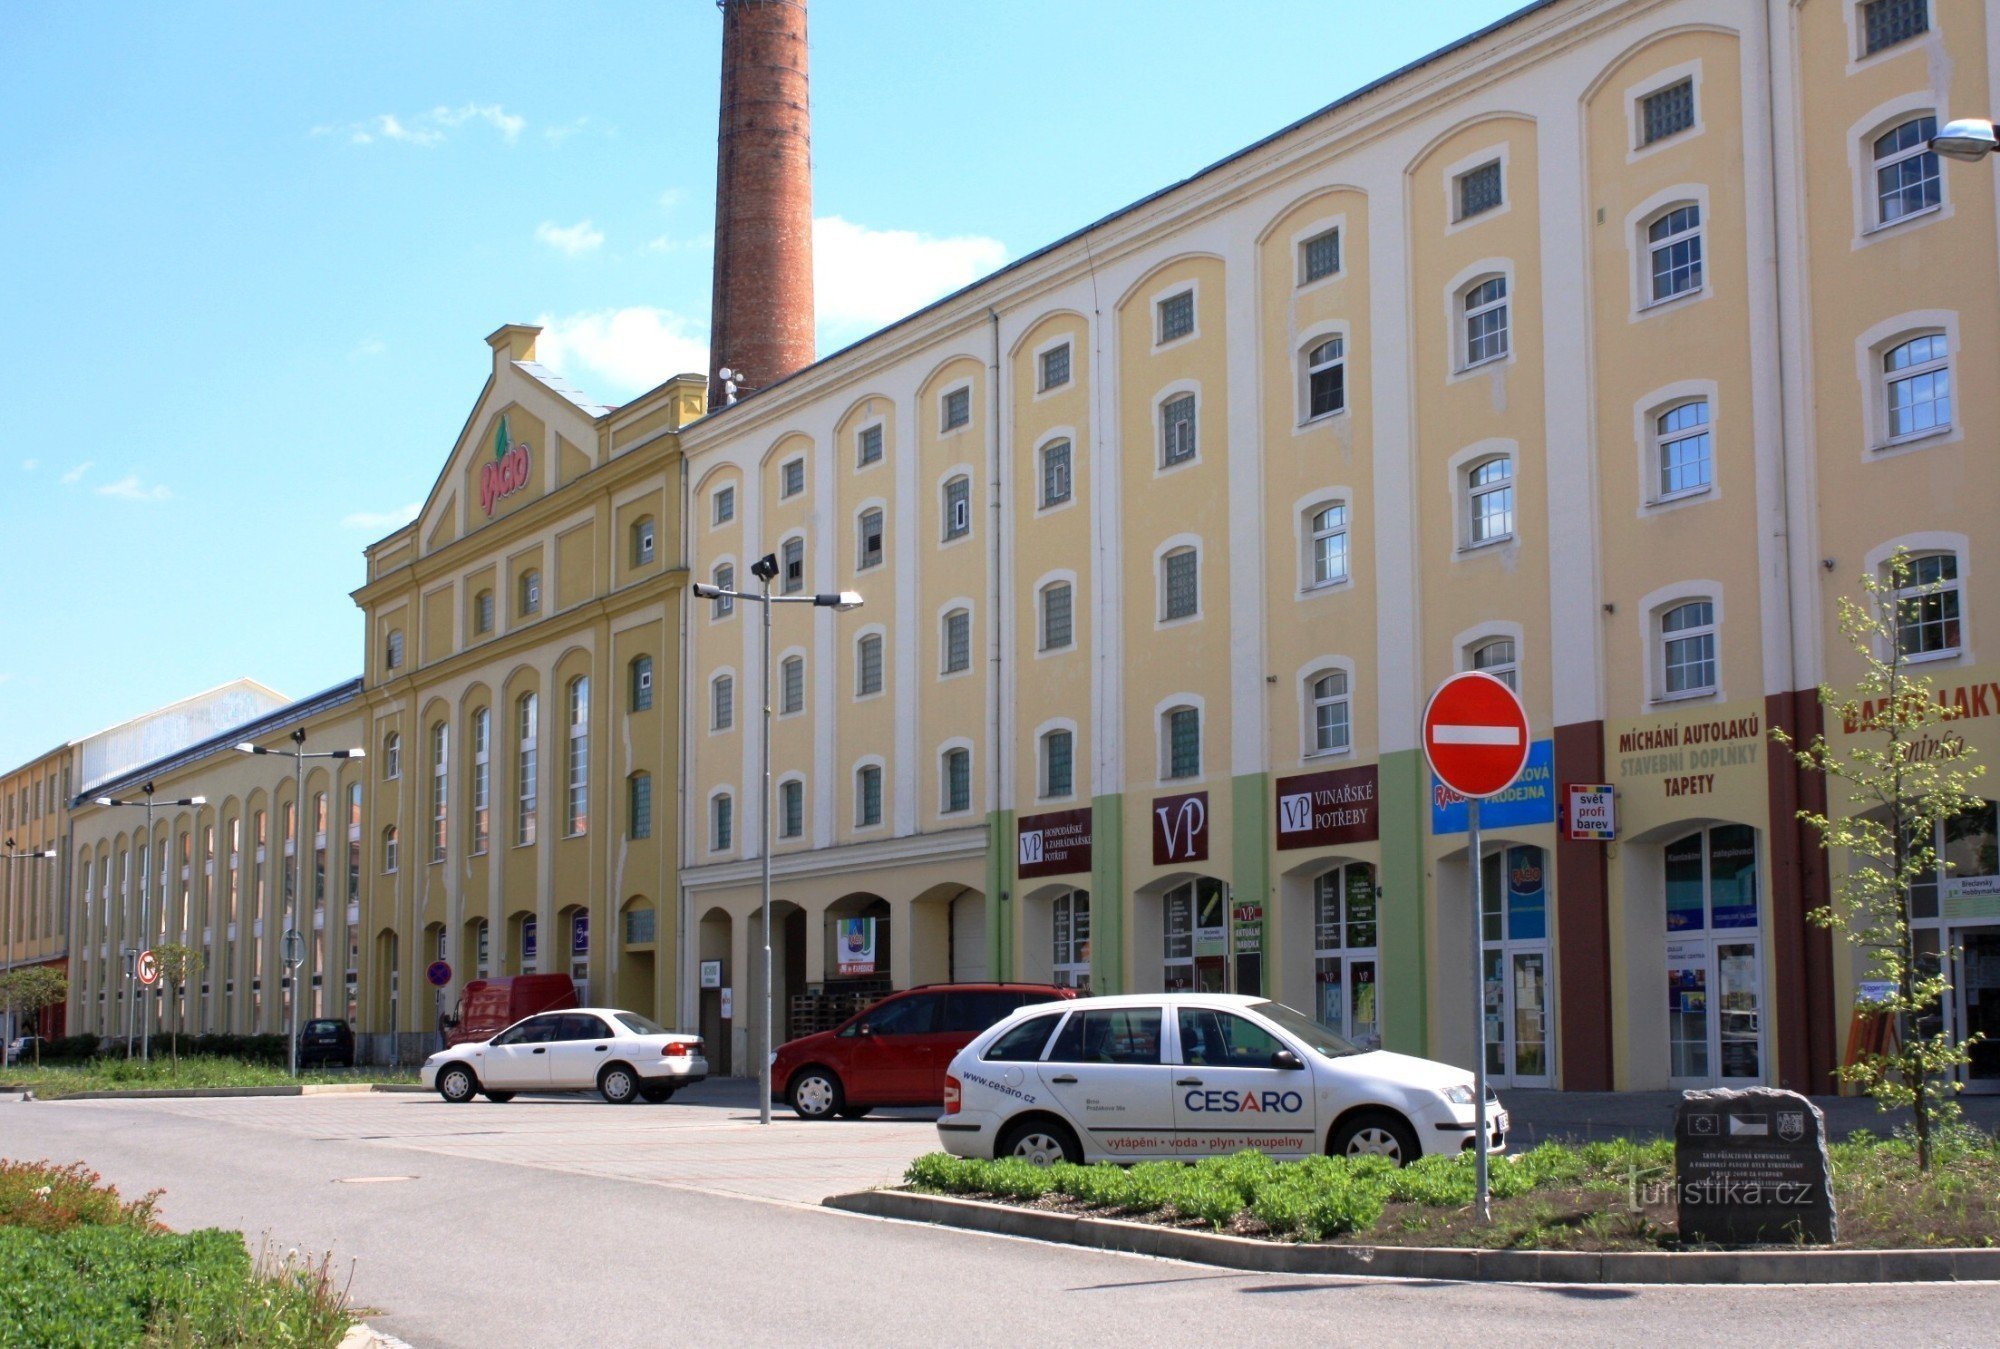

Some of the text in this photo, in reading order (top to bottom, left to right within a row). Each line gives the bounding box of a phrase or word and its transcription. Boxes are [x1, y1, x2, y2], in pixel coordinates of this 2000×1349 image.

[1619, 712, 1759, 753] MÍCHÁNÍ AUTOLAKŮ
[1620, 742, 1758, 777] STAVEBNÍ DOPLŇKY
[1315, 780, 1374, 804] VINAŘSKÉ
[1484, 785, 1545, 804] PRODEJNA
[1664, 774, 1715, 797] TAPETY
[1580, 793, 1604, 805] svět
[1283, 796, 1310, 828] VP
[1315, 807, 1368, 829] POTŘEBY
[1579, 807, 1605, 819] profi
[1044, 823, 1082, 837] HOSPODÁŘSKÉ
[1156, 797, 1205, 860] VP
[1577, 818, 1608, 829] barev
[1022, 833, 1041, 861] VP
[1045, 850, 1067, 862] POTŘEBY
[1962, 888, 2000, 896] Hobbymarke
[963, 1071, 1036, 1104] www.cesaro.cz
[1185, 1090, 1302, 1113] CESARO
[1107, 1136, 1304, 1150] vytápění voda plyn koupelny
